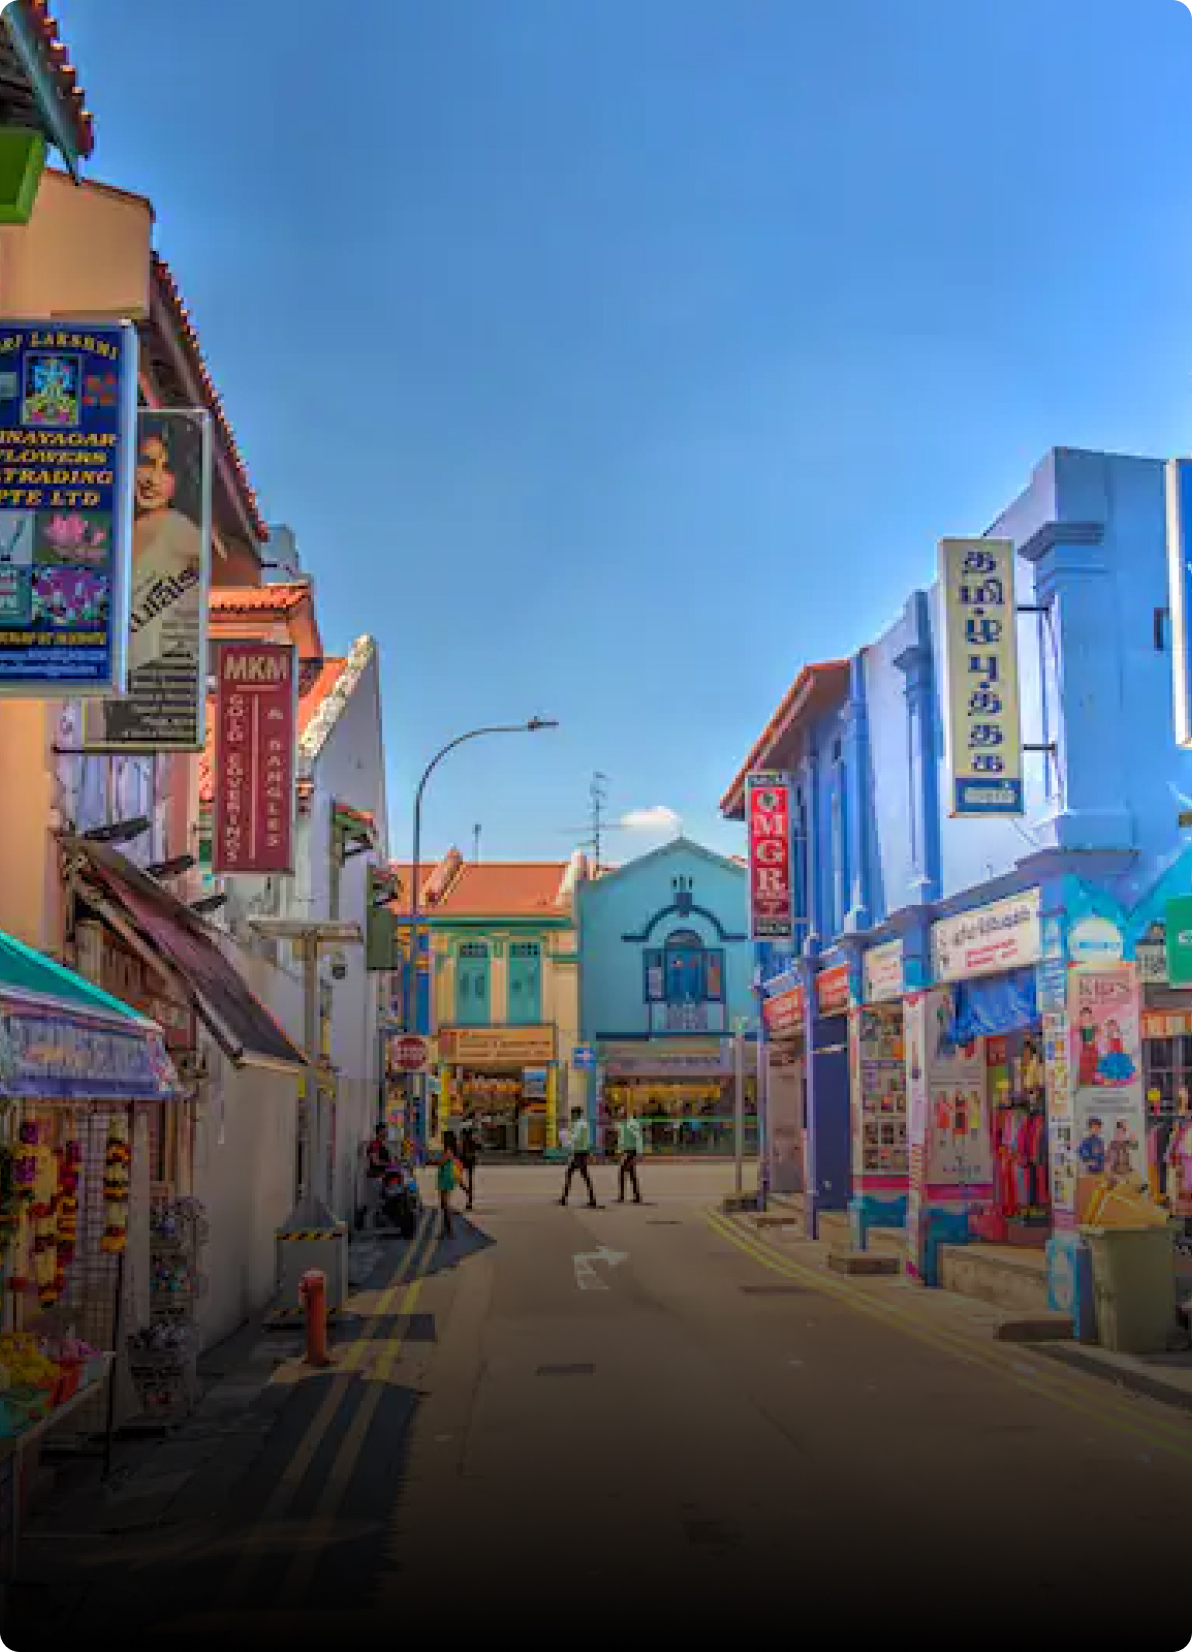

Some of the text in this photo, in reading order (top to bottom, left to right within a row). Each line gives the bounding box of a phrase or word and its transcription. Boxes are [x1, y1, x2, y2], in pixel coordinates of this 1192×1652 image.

[4, 469, 113, 485] TRADING
[50, 490, 101, 507] LTD
[224, 653, 288, 682] MKM
[266, 740, 284, 847] BANGLES
